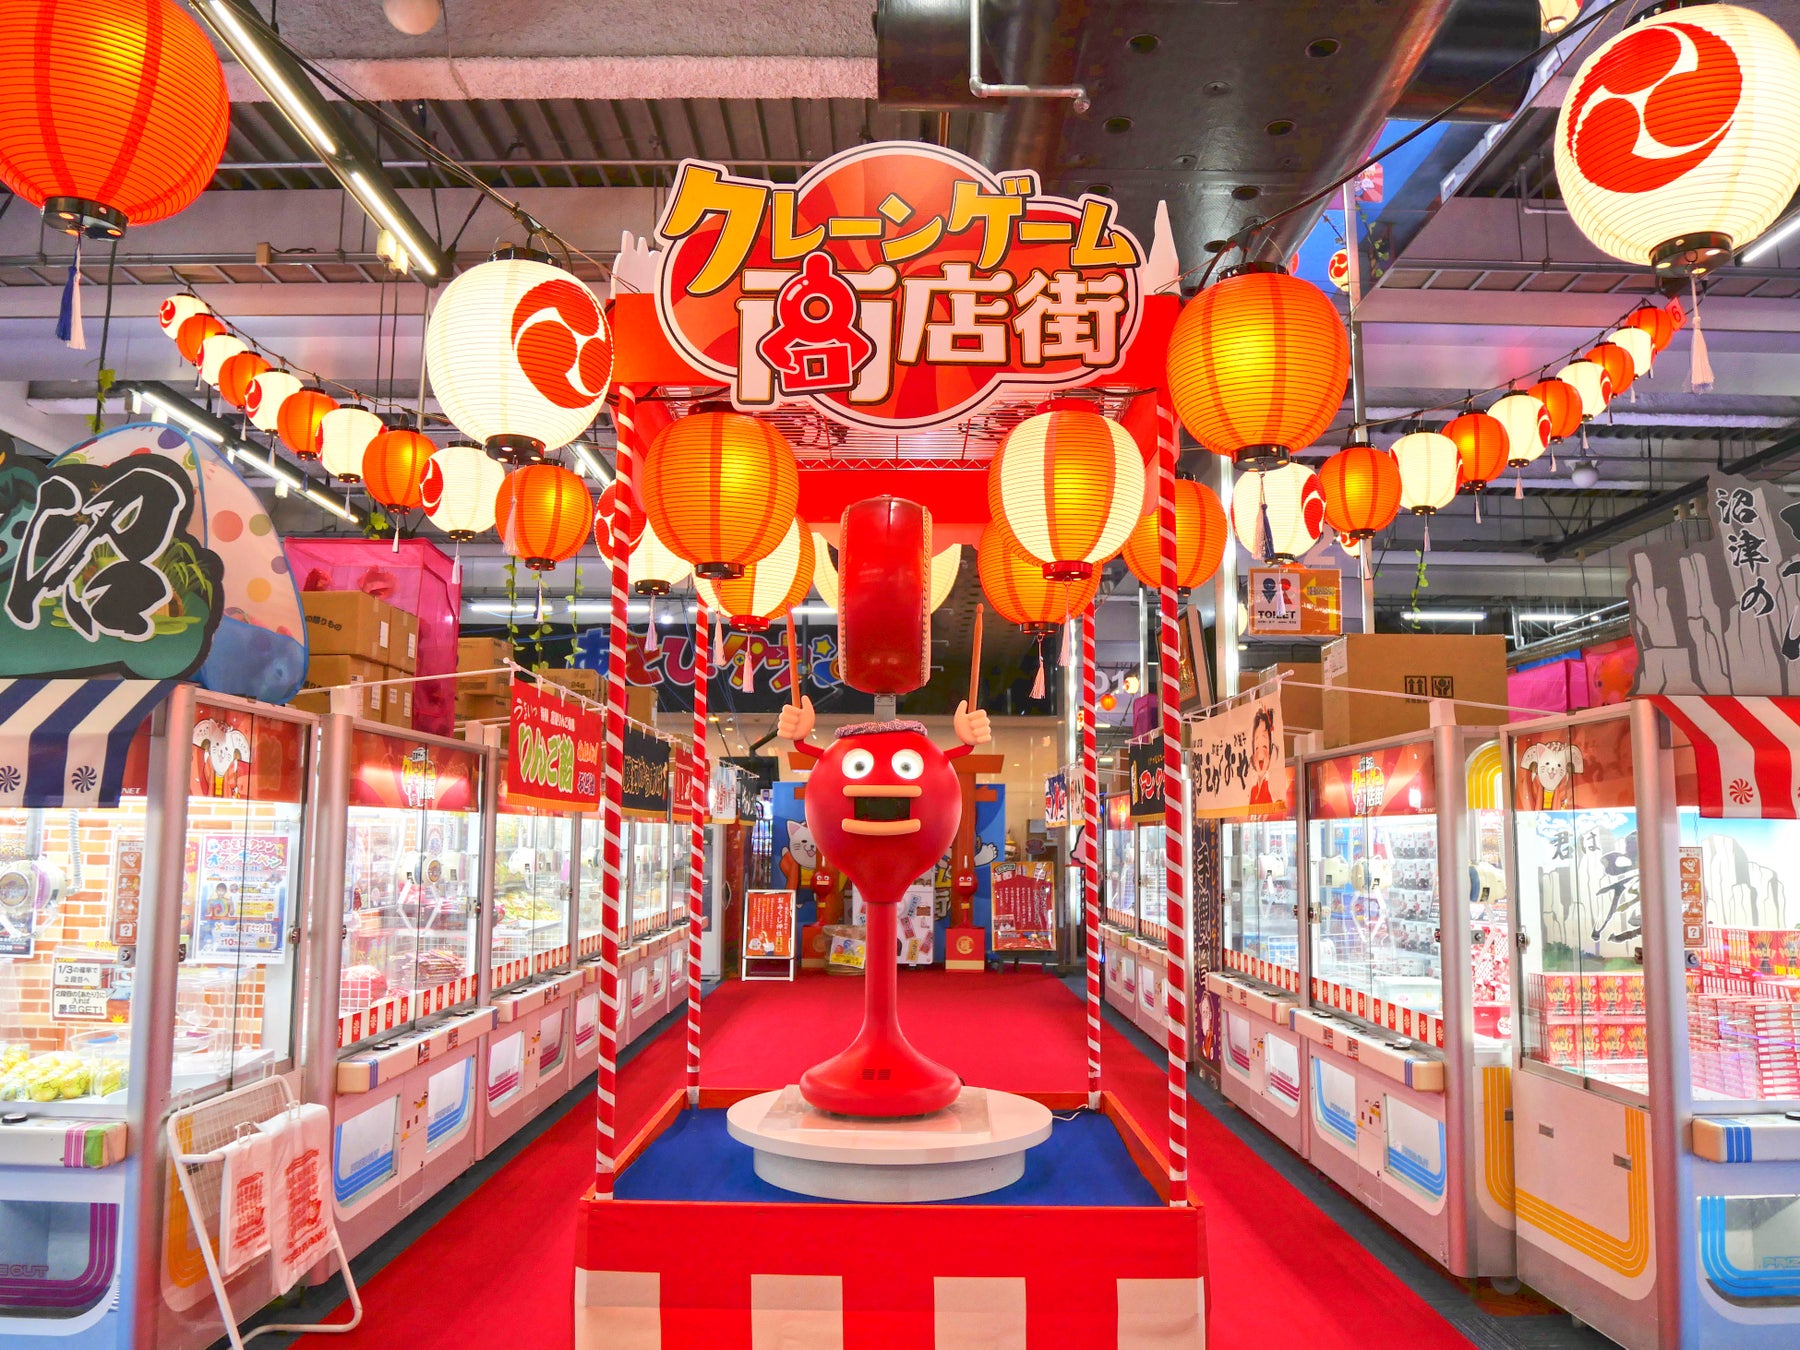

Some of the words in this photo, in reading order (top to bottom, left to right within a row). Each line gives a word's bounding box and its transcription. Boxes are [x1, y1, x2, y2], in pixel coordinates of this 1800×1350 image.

[661, 163, 1138, 294] クレーンゲーム
[736, 250, 1127, 403] 商店街
[1671, 305, 1682, 323] 6
[1715, 487, 1776, 618] 沼津の
[518, 722, 575, 794] りんご飴
[1549, 831, 1602, 861] 君は
[11, 1264, 49, 1278] OUT
